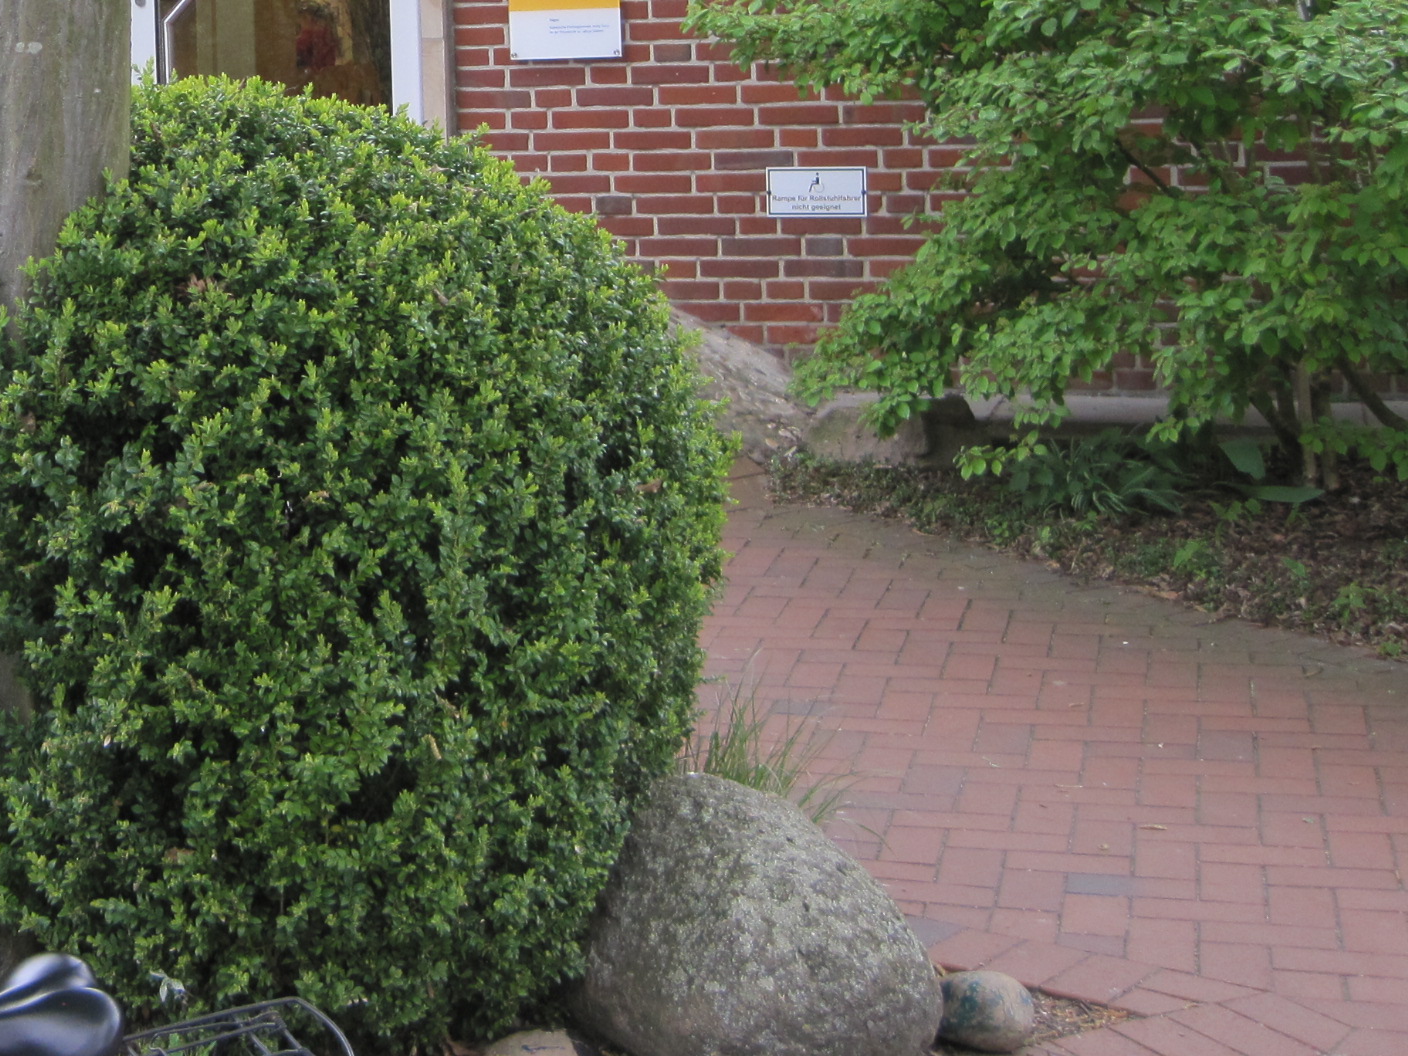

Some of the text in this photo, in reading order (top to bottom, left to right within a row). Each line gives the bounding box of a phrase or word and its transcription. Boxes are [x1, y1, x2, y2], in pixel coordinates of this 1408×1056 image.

[772, 194, 861, 203] Rampe für Rollstuhlfahrer
